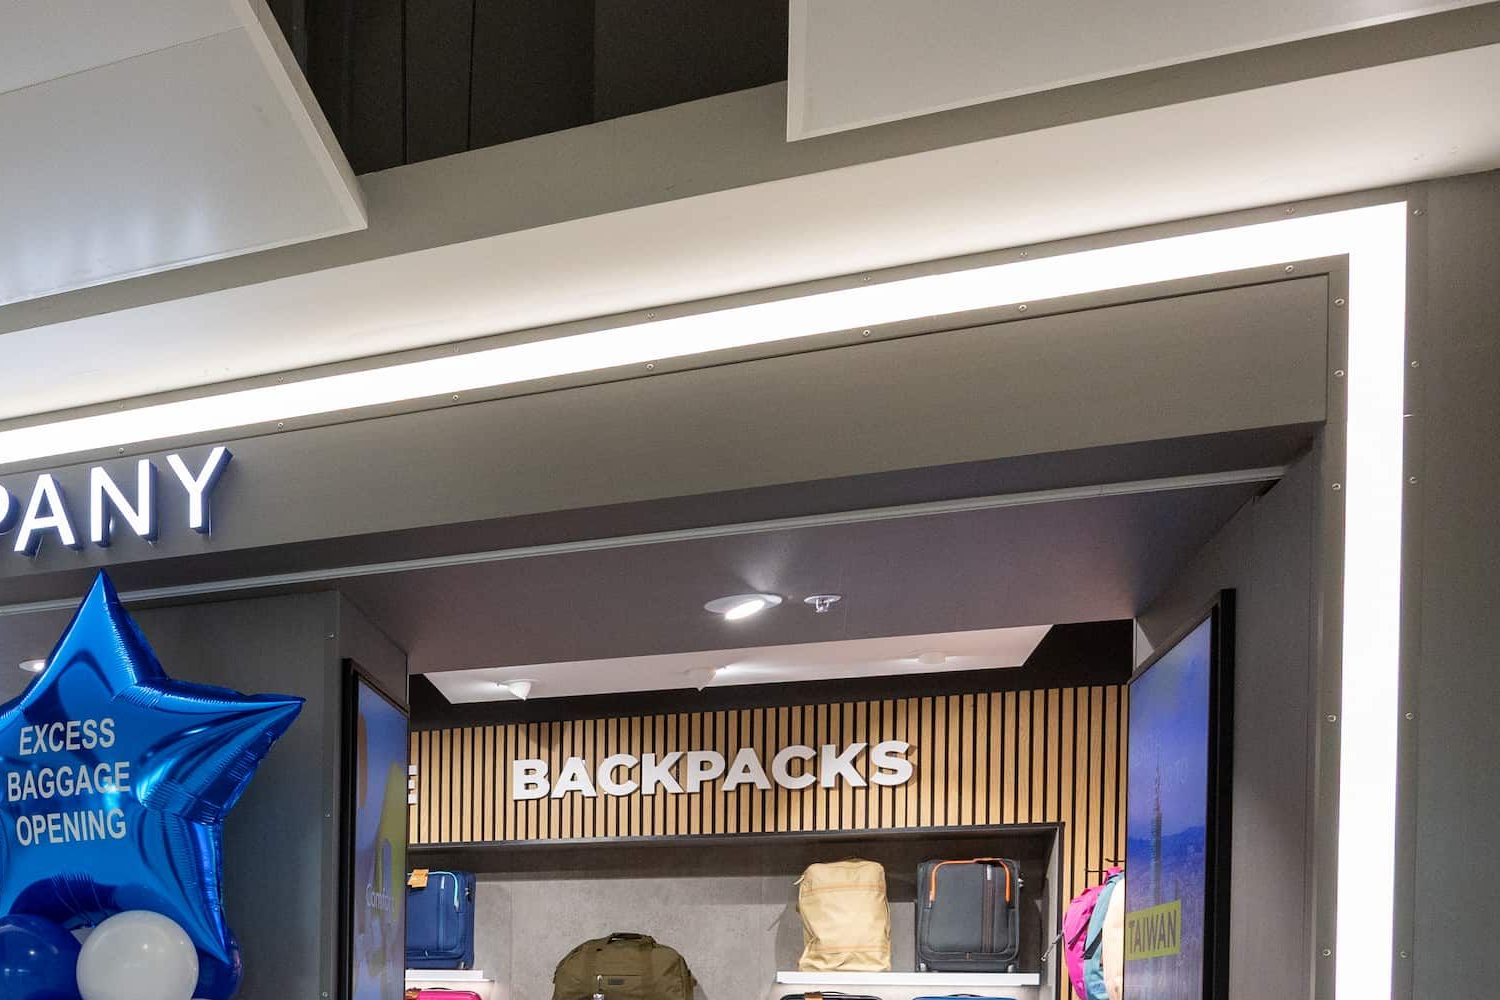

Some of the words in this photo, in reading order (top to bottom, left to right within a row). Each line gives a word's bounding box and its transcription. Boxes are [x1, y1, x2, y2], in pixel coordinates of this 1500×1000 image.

[19, 718, 115, 756] EXCESS
[7, 761, 131, 802] BAGGAGE
[513, 740, 917, 800] BACKPACKS
[16, 808, 127, 847] OPENING
[1128, 909, 1177, 953] TAIWAN
